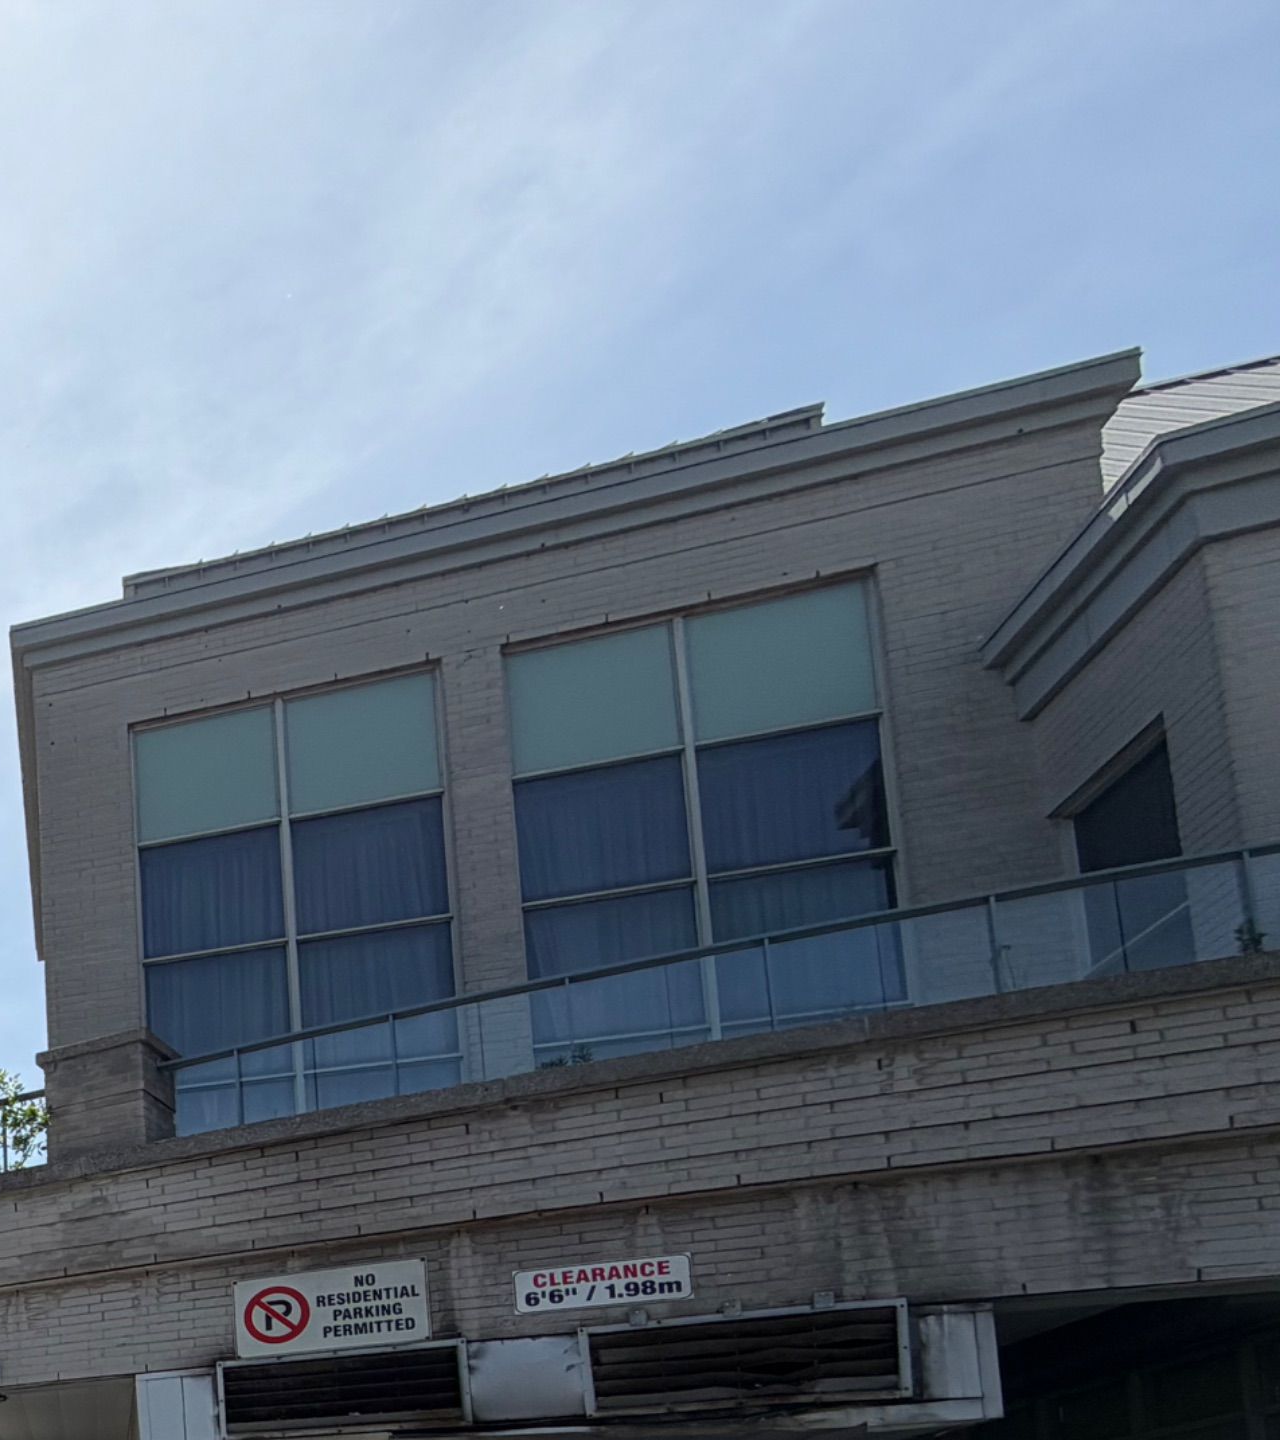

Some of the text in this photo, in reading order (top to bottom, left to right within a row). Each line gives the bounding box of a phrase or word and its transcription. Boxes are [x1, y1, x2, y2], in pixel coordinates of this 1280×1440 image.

[354, 1273, 376, 1288] NO
[532, 1260, 671, 1289] CLEARANCE
[316, 1284, 420, 1308] RESIDENTIAL
[604, 1279, 683, 1300] 1.98m
[333, 1302, 403, 1322] PARKING
[323, 1317, 416, 1339] PERMITTED
